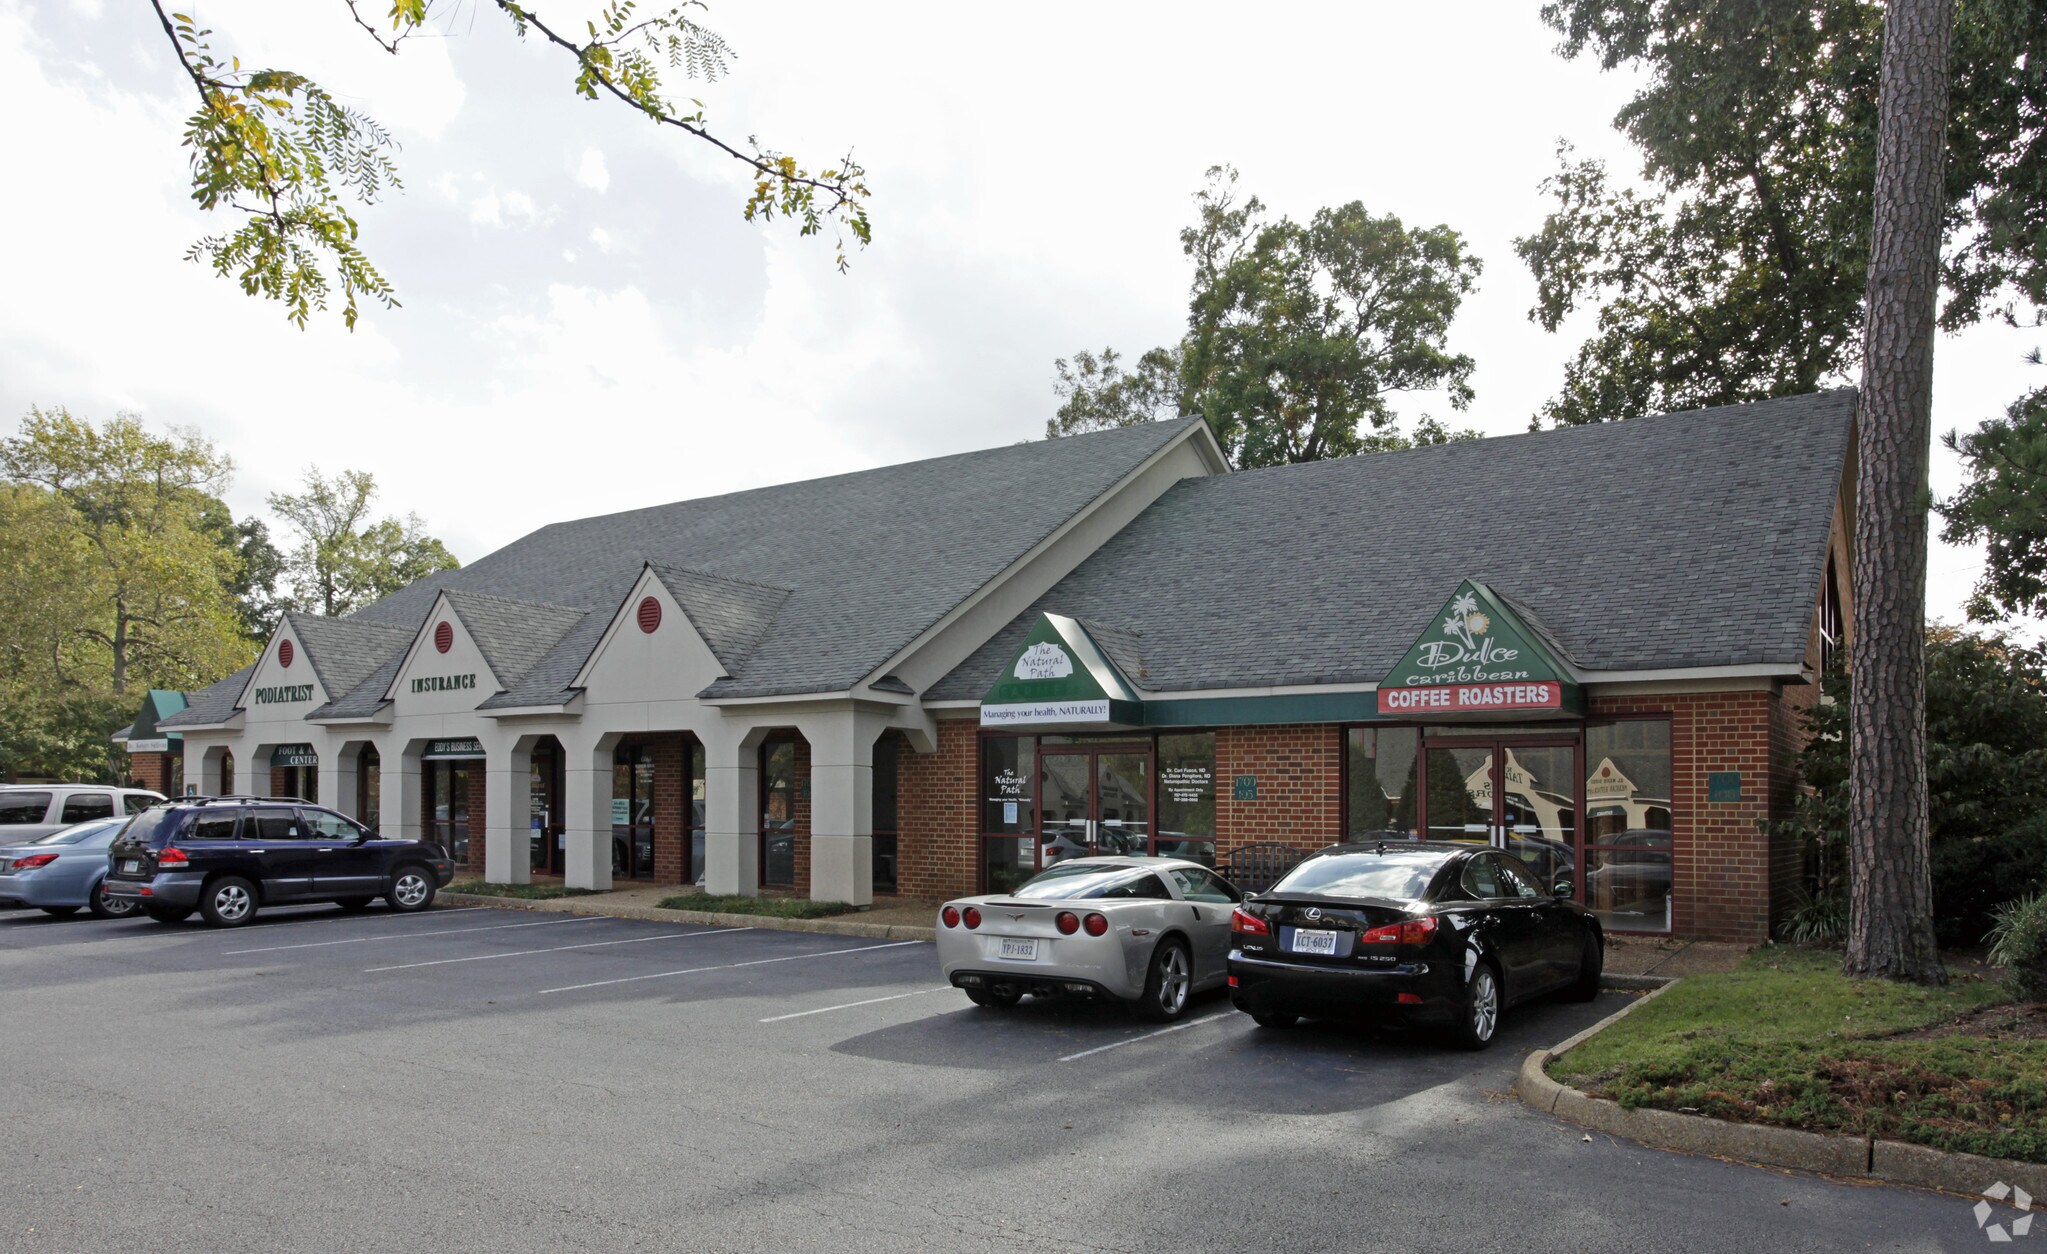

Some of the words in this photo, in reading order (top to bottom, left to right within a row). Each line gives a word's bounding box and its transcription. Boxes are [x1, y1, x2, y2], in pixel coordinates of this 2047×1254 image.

[1033, 643, 1051, 655] The
[1416, 637, 1518, 670] Dulce
[1022, 654, 1064, 667] Natural
[1029, 668, 1055, 679] Path
[411, 673, 476, 693] INSURANCE
[255, 684, 314, 704] PODIATRIST
[1388, 689, 1450, 708] COFFEE
[1459, 685, 1549, 706] ROASTERS
[983, 708, 1016, 720] Managing
[1017, 710, 1032, 719] your
[1034, 707, 1057, 717] health,
[1059, 705, 1106, 716] NATURALLY!
[278, 746, 296, 755] FOOT
[451, 741, 472, 752] BUSINESS
[290, 755, 318, 765] CENTER
[1003, 768, 1014, 776] The
[994, 775, 1027, 784] Natural
[1000, 784, 1021, 795] Path
